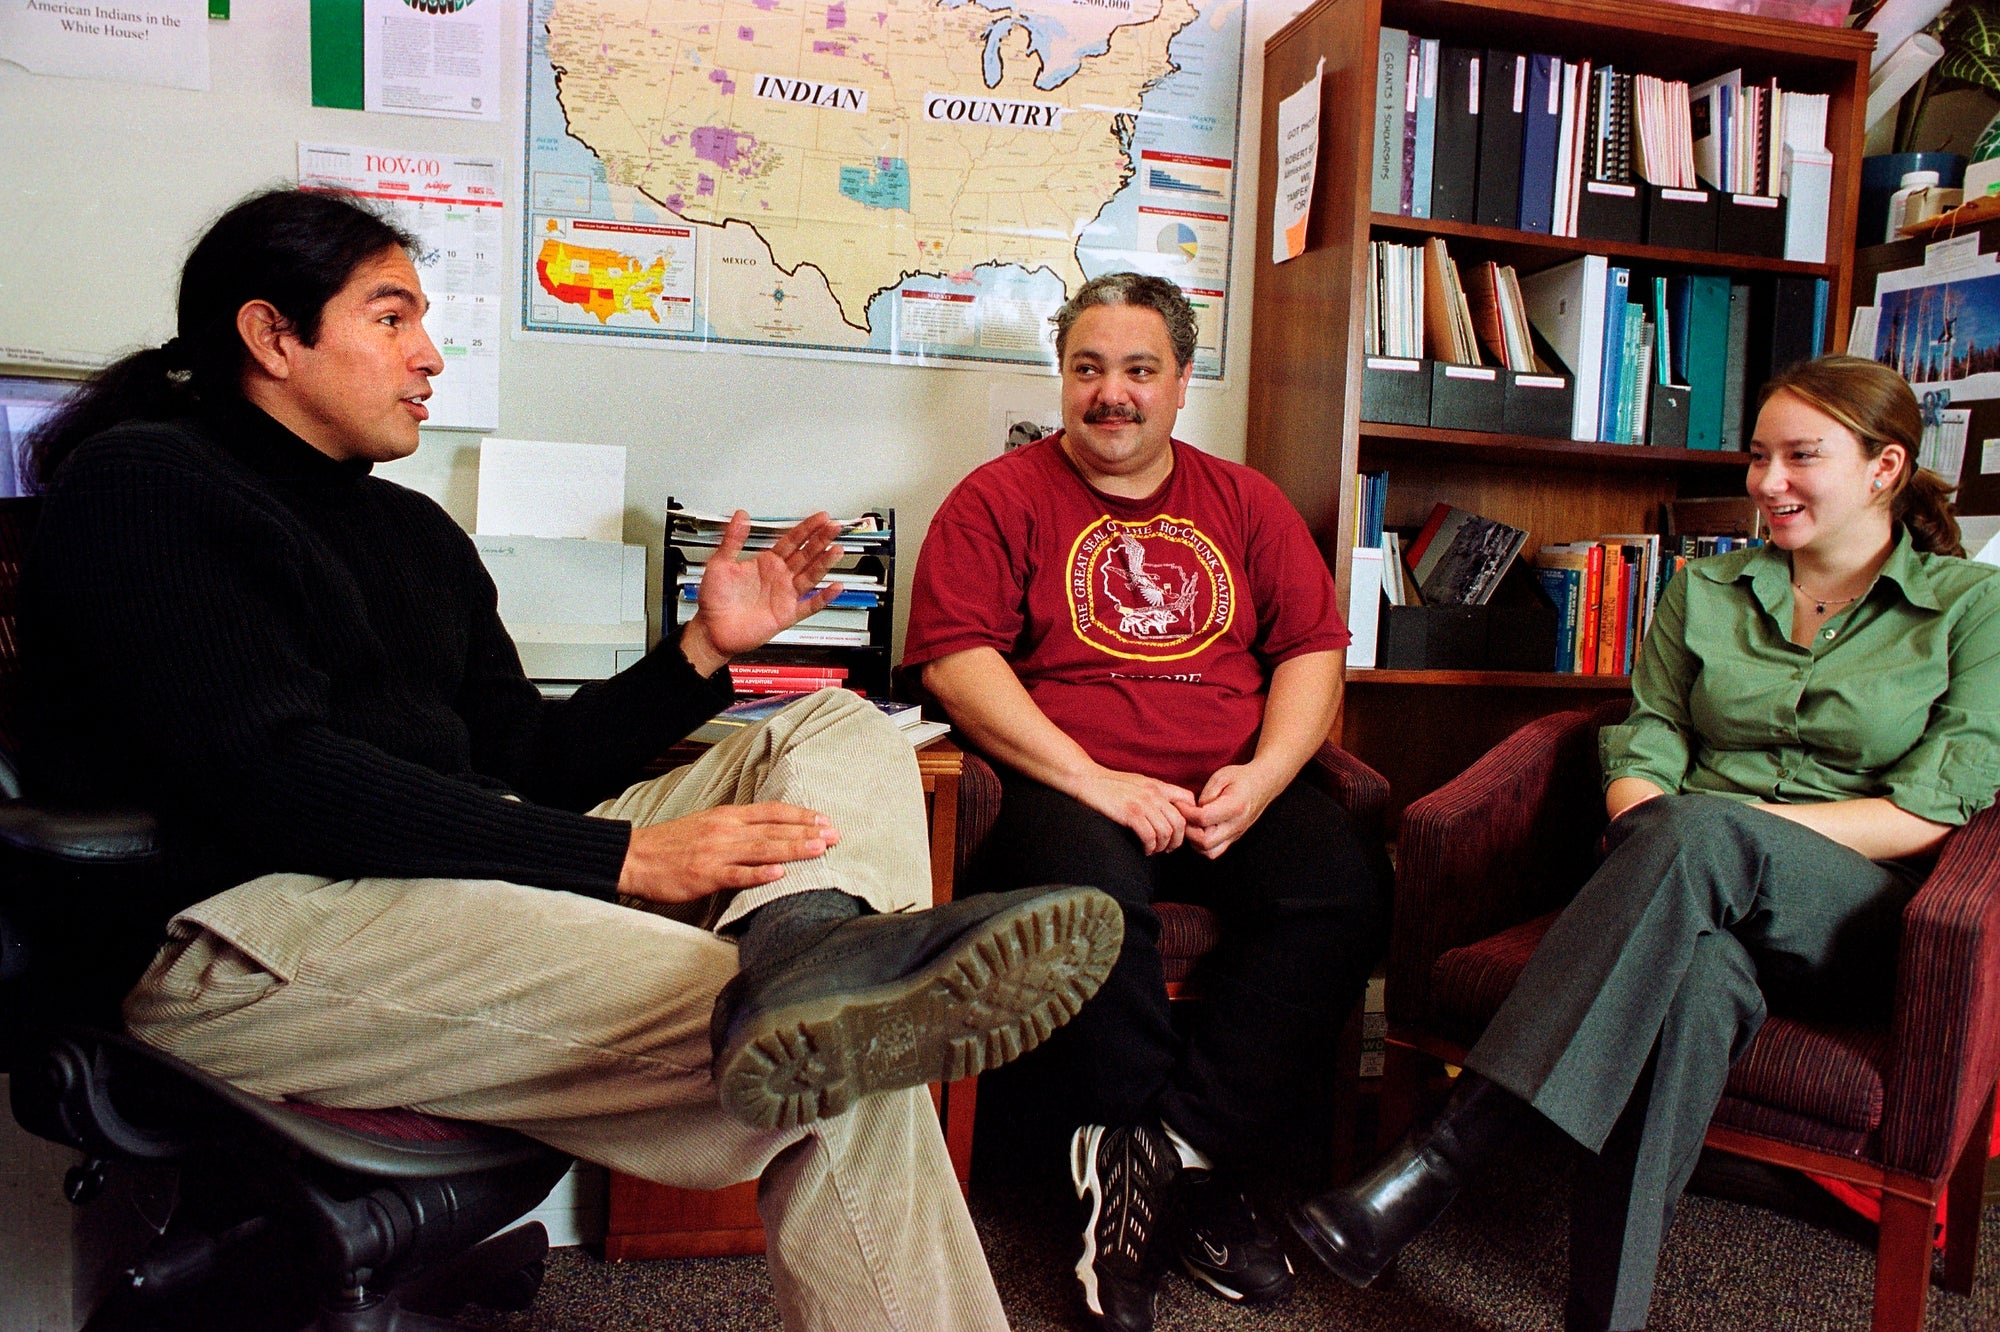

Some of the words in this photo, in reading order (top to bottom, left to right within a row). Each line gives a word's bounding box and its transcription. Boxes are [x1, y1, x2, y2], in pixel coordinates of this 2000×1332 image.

[26, 0, 91, 16] American
[95, 6, 143, 23] Indians
[146, 12, 159, 25] in
[161, 13, 181, 28] the
[60, 19, 101, 35] White
[104, 23, 150, 40] House!
[1384, 52, 1394, 99] GRANTS
[757, 76, 865, 111] INDIAN
[928, 98, 1060, 127] COUNTRY
[365, 154, 440, 177] nov.00
[722, 257, 757, 266] MEXICO
[1106, 521, 1117, 532] O
[1082, 529, 1108, 554] SEAL
[1074, 553, 1089, 598] GREAT
[1216, 572, 1229, 625] NATION
[1077, 603, 1091, 632] THE
